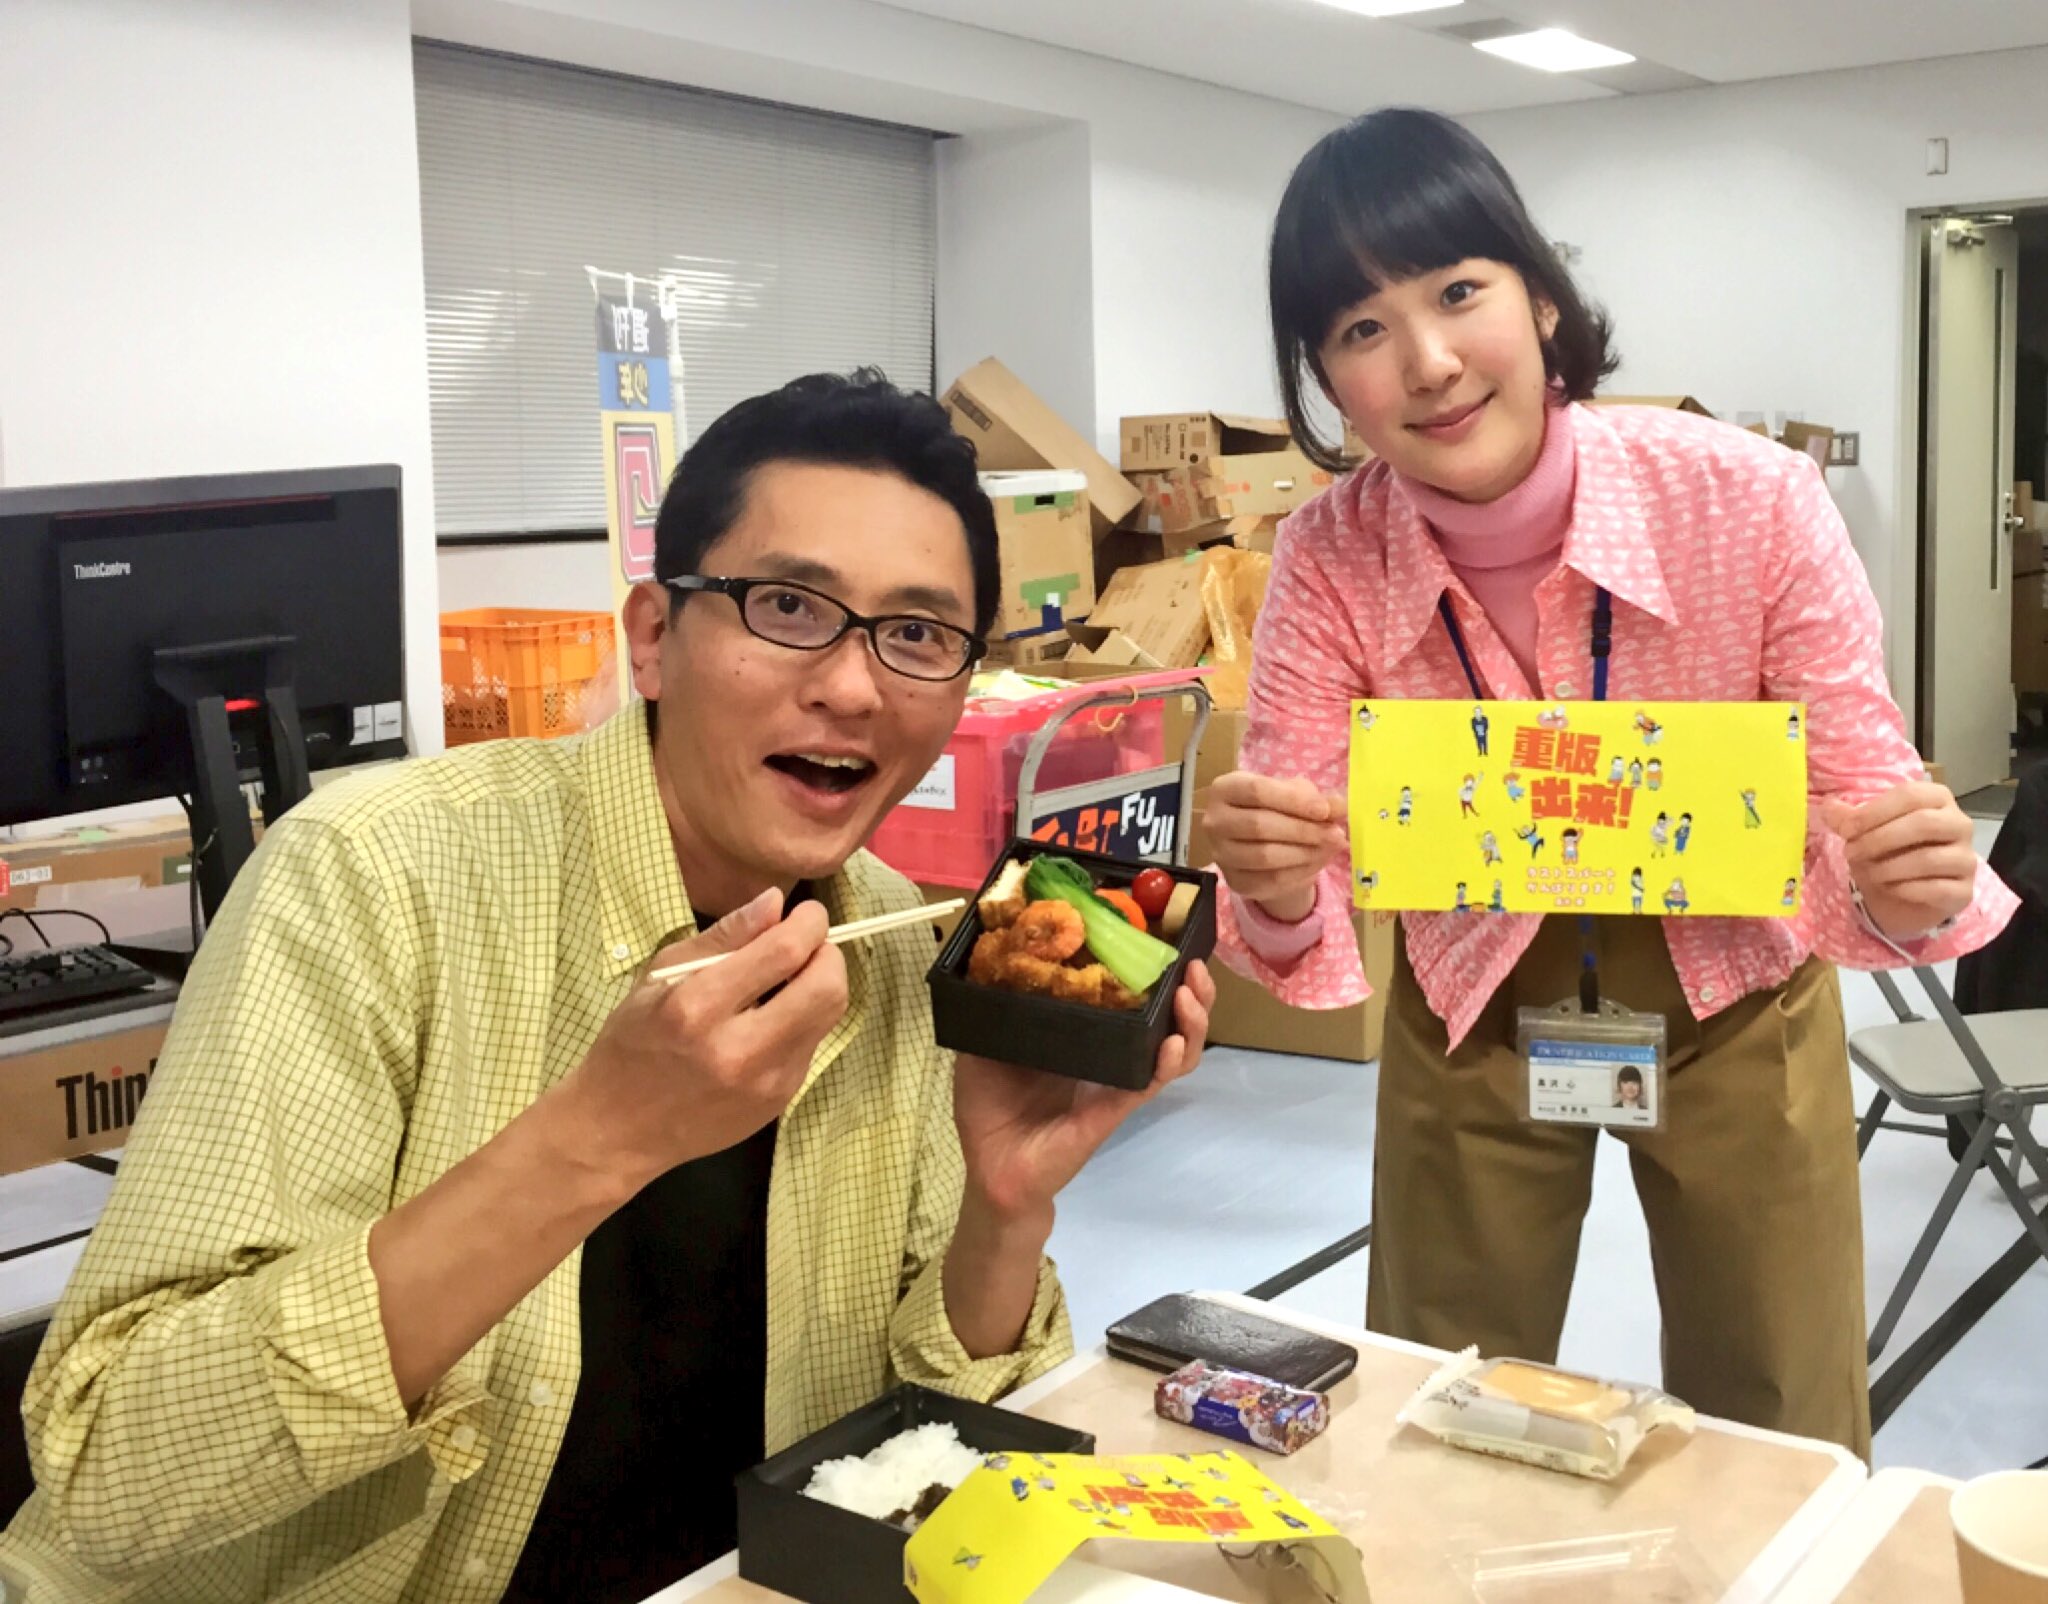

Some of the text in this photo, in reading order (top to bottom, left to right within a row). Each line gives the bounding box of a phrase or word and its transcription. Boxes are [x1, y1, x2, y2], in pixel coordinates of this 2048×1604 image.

[74, 561, 130, 579] ThinkCentre
[1511, 725, 1601, 777] 重版
[1530, 776, 1634, 829] 出来!
[56, 1057, 158, 1140] Thin
